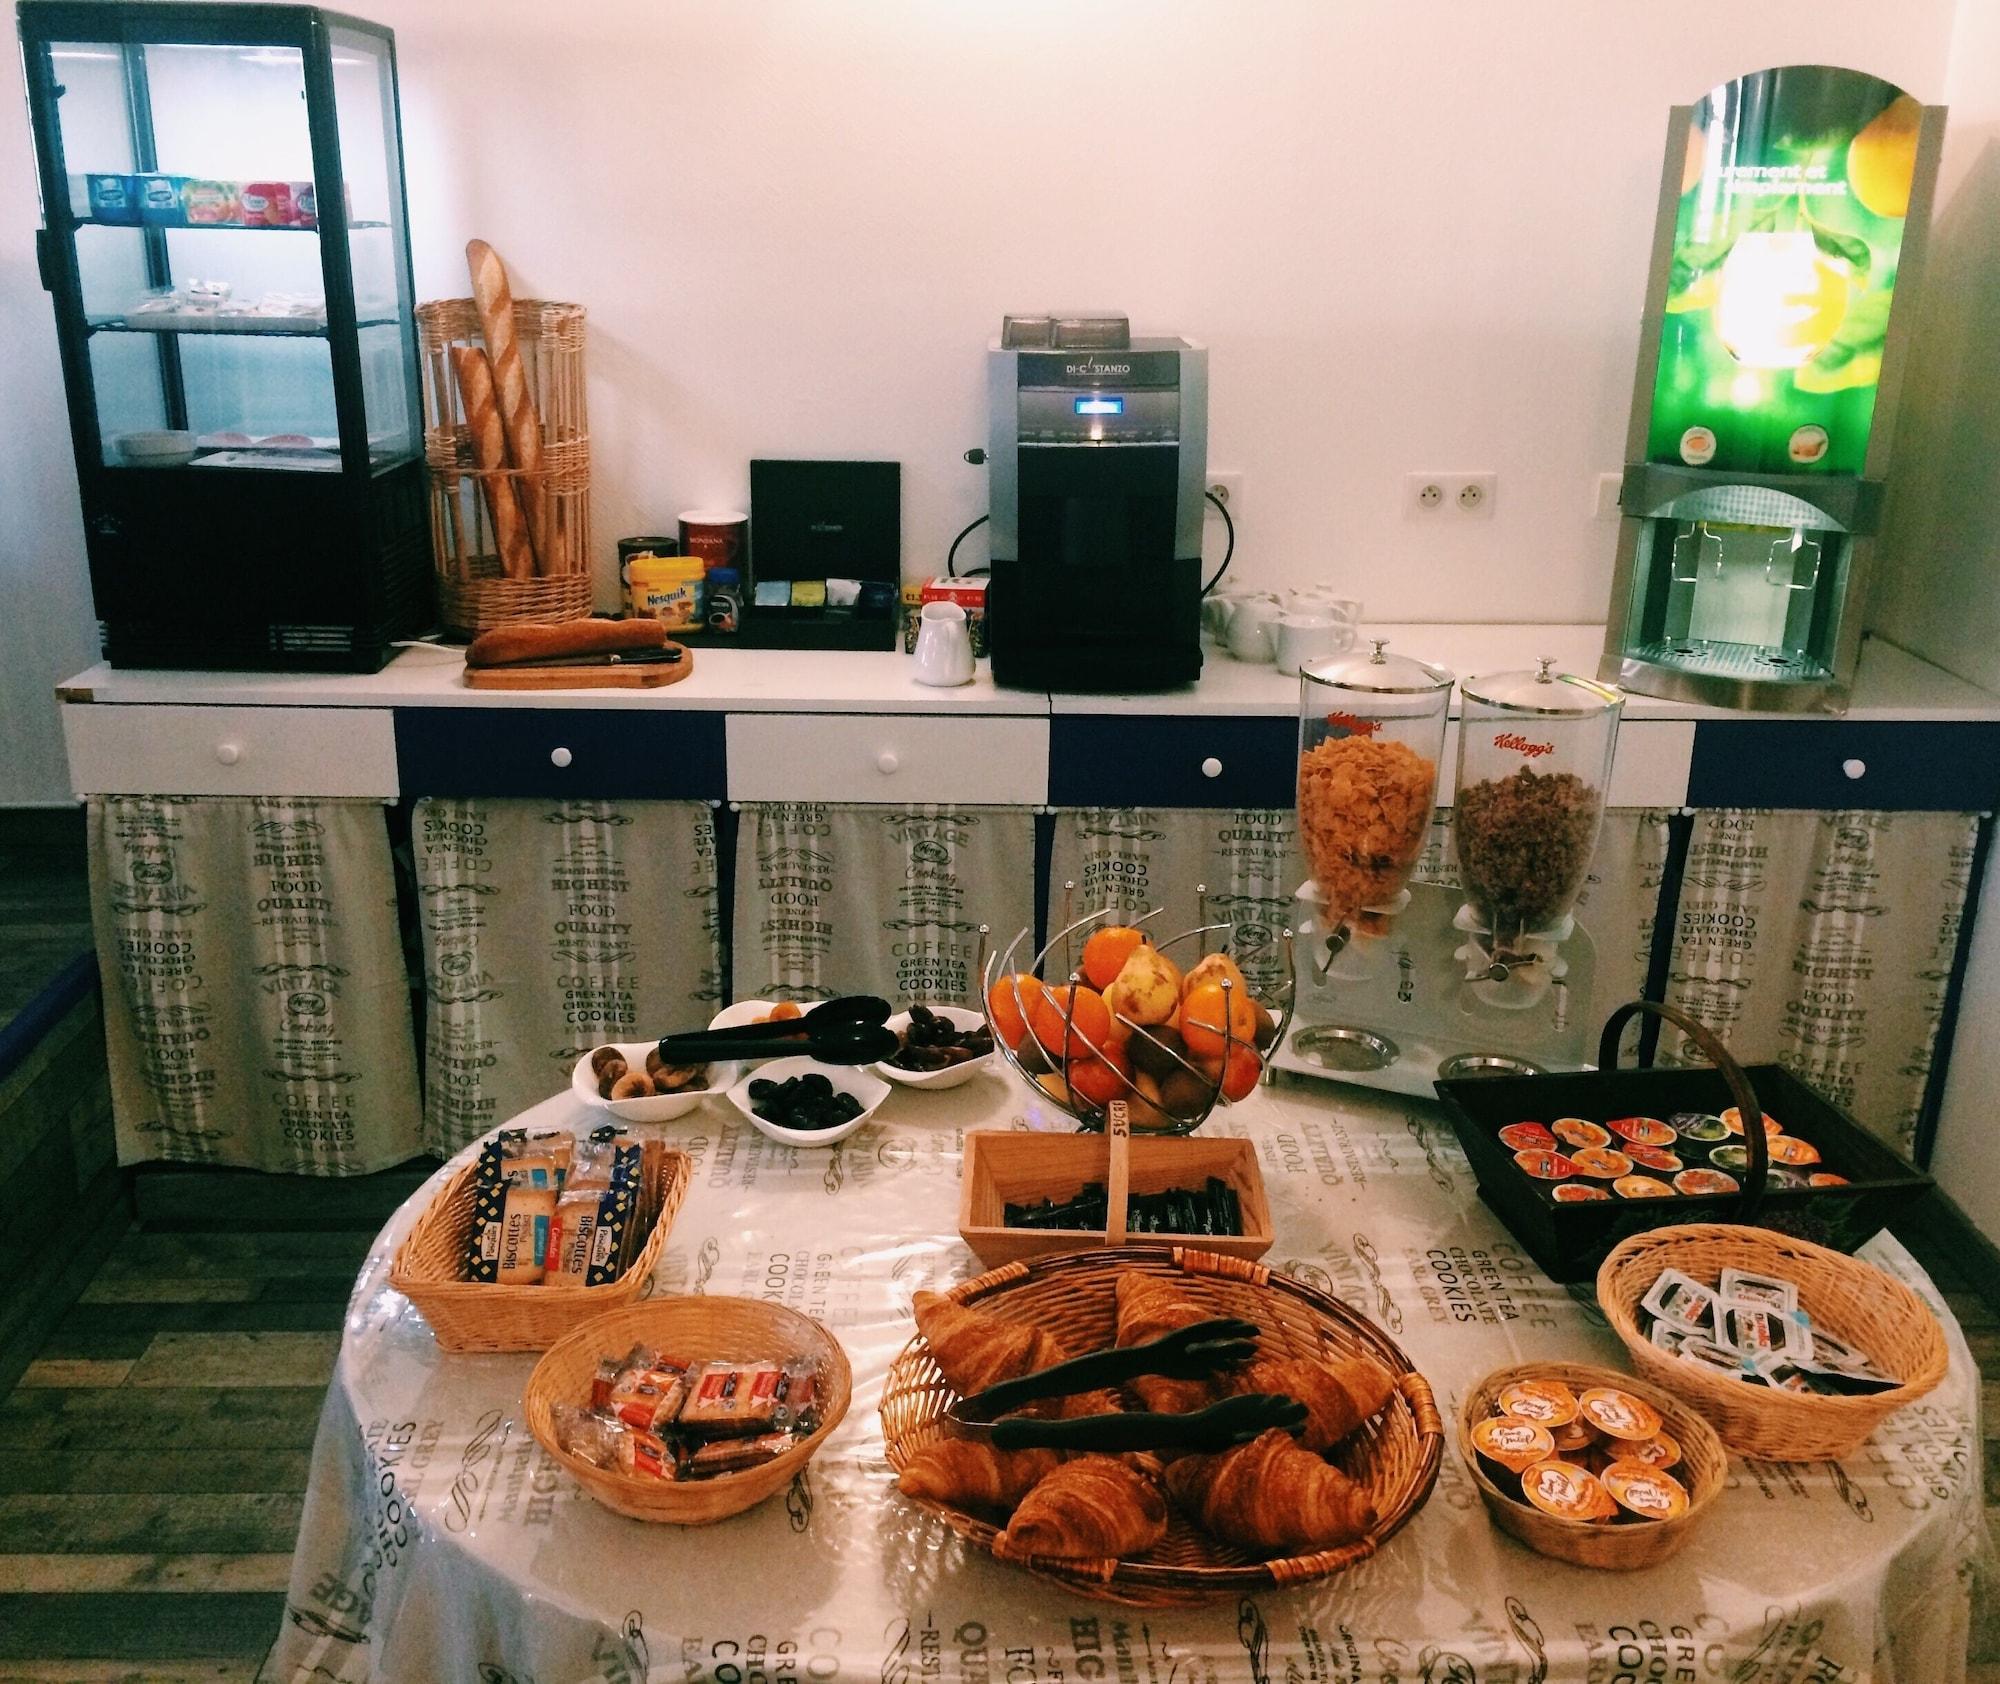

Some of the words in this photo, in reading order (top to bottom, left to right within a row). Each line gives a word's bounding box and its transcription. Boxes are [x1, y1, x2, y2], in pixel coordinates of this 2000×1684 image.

[647, 588, 688, 606] Nesquik
[1494, 732, 1555, 759] Kellogg's
[1234, 812, 1283, 826] FOOD
[889, 824, 970, 849] VINTAGE
[1218, 829, 1297, 843] QUALITY
[905, 865, 959, 887] Cooking
[1084, 860, 1147, 877] COOKIES
[271, 880, 322, 893] FOOD
[551, 879, 631, 892] HIGHEST
[1084, 886, 1102, 898] TEA
[1105, 883, 1145, 898] GREEN
[770, 891, 820, 907] FOOD
[1076, 896, 1151, 915] COFFEE
[568, 904, 616, 918] FOOD
[1212, 904, 1292, 928] VINTAGE
[553, 921, 633, 935] QUALITY
[759, 918, 834, 936] HIGHEST
[1682, 912, 1756, 929] COOKIES
[1680, 935, 1703, 946] TEA
[1707, 936, 1753, 950] GREEN
[891, 941, 972, 960] COFFEE
[900, 957, 941, 968] GREEN
[944, 958, 967, 970] TEA
[556, 974, 641, 990] COFFEE
[896, 968, 968, 980] CHOCOLATE
[899, 978, 968, 992] COOKIES
[565, 990, 608, 1000] GREEN
[611, 991, 634, 1001] TEA
[1803, 989, 1854, 1005] FOOD
[562, 1000, 638, 1012] CHOCOLATE
[566, 1010, 637, 1024] COOKIES
[272, 1092, 357, 1110] COFFEE
[281, 1108, 323, 1121] GREEN
[327, 1111, 352, 1121] TEA
[284, 1127, 356, 1142] COOKIES
[1276, 1134, 1308, 1174] FOOD
[1300, 1121, 1344, 1186] QUALITY
[762, 1253, 790, 1300] COOK
[1425, 1249, 1478, 1323] COOKIES
[1448, 1246, 1499, 1326] CHOCOLATE
[1470, 1249, 1506, 1291] GREEN
[1495, 1295, 1522, 1321] TEA
[1490, 1243, 1559, 1329] COFFEE
[378, 1421, 417, 1549] COOKIES
[1338, 1623, 1365, 1684] ORIGINA
